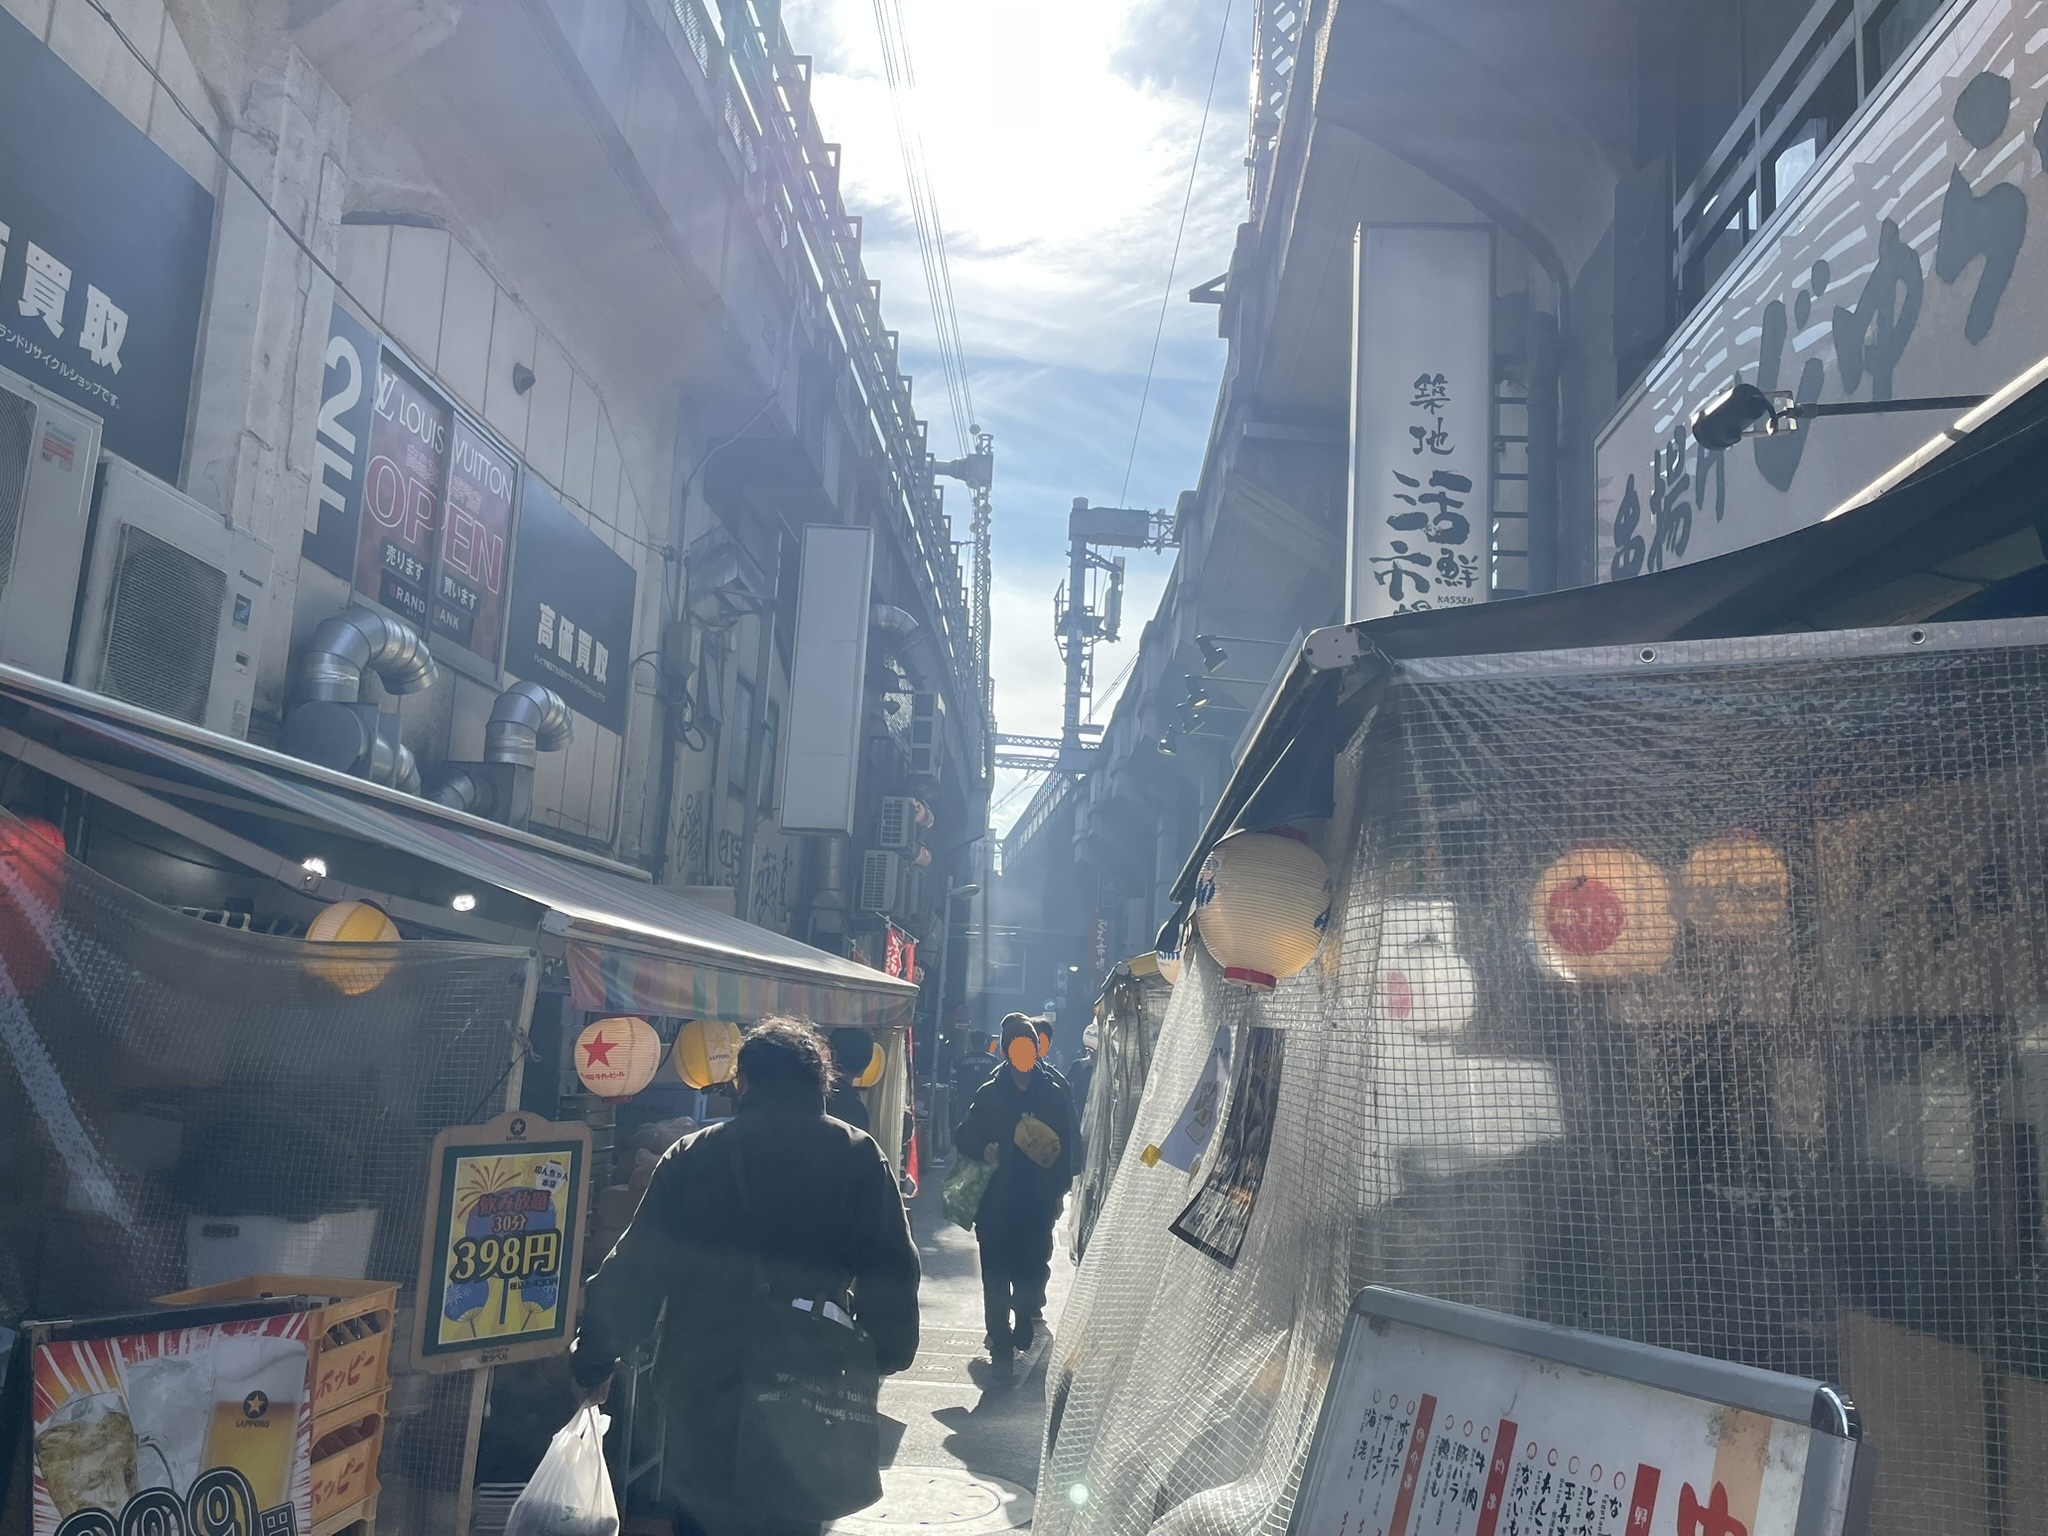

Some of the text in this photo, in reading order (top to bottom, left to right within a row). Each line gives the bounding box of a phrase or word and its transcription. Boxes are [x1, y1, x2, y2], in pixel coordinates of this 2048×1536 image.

[0, 221, 129, 375] 買取
[400, 393, 513, 505] LOUIS VUITTON
[386, 544, 424, 581] 売ります
[389, 582, 426, 613] BRAND
[443, 576, 477, 610] 買います
[1437, 595, 1474, 605] KASSEN
[537, 602, 609, 685] 高価買取
[479, 1190, 549, 1216] 飲み放題
[493, 1213, 527, 1232] 30分
[454, 1232, 559, 1280] 398円
[315, 1350, 375, 1399] ホッピー
[234, 1420, 270, 1428] SAPPORO
[1371, 1413, 1394, 1480] サーモン
[1390, 1419, 1410, 1478] ホタテ
[1508, 1463, 1533, 1536] ながいも
[1534, 1469, 1543, 1495] Lotus
[1555, 1477, 1565, 1504] Onion
[1576, 1485, 1586, 1518] Potato
